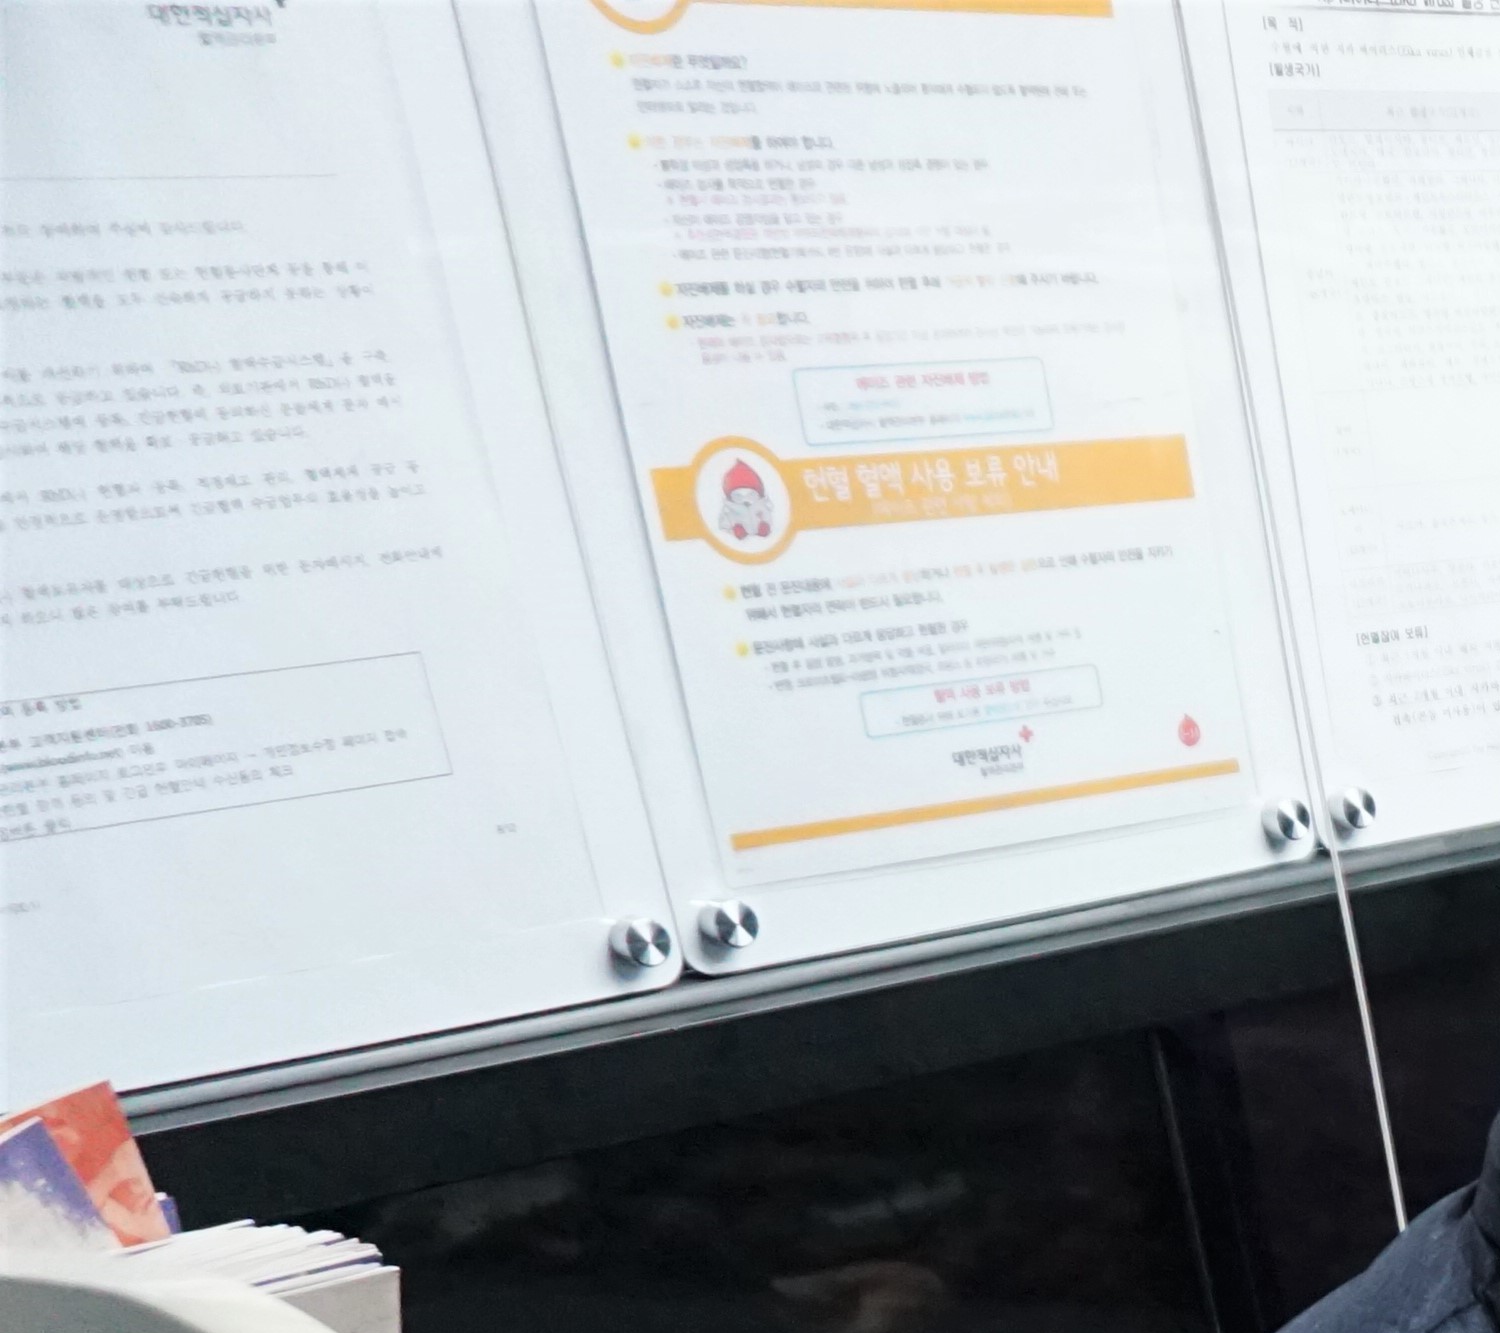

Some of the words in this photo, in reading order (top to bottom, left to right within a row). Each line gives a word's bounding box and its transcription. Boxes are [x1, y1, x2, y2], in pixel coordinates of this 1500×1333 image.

[146, 5, 270, 27] 대한적십자사
[803, 465, 852, 502] 헌혈
[854, 461, 904, 500] 혈액
[911, 457, 955, 493] 사용
[965, 455, 1008, 488] 보류
[1012, 451, 1060, 487] 안내
[952, 745, 1023, 770] 대한적십자사
